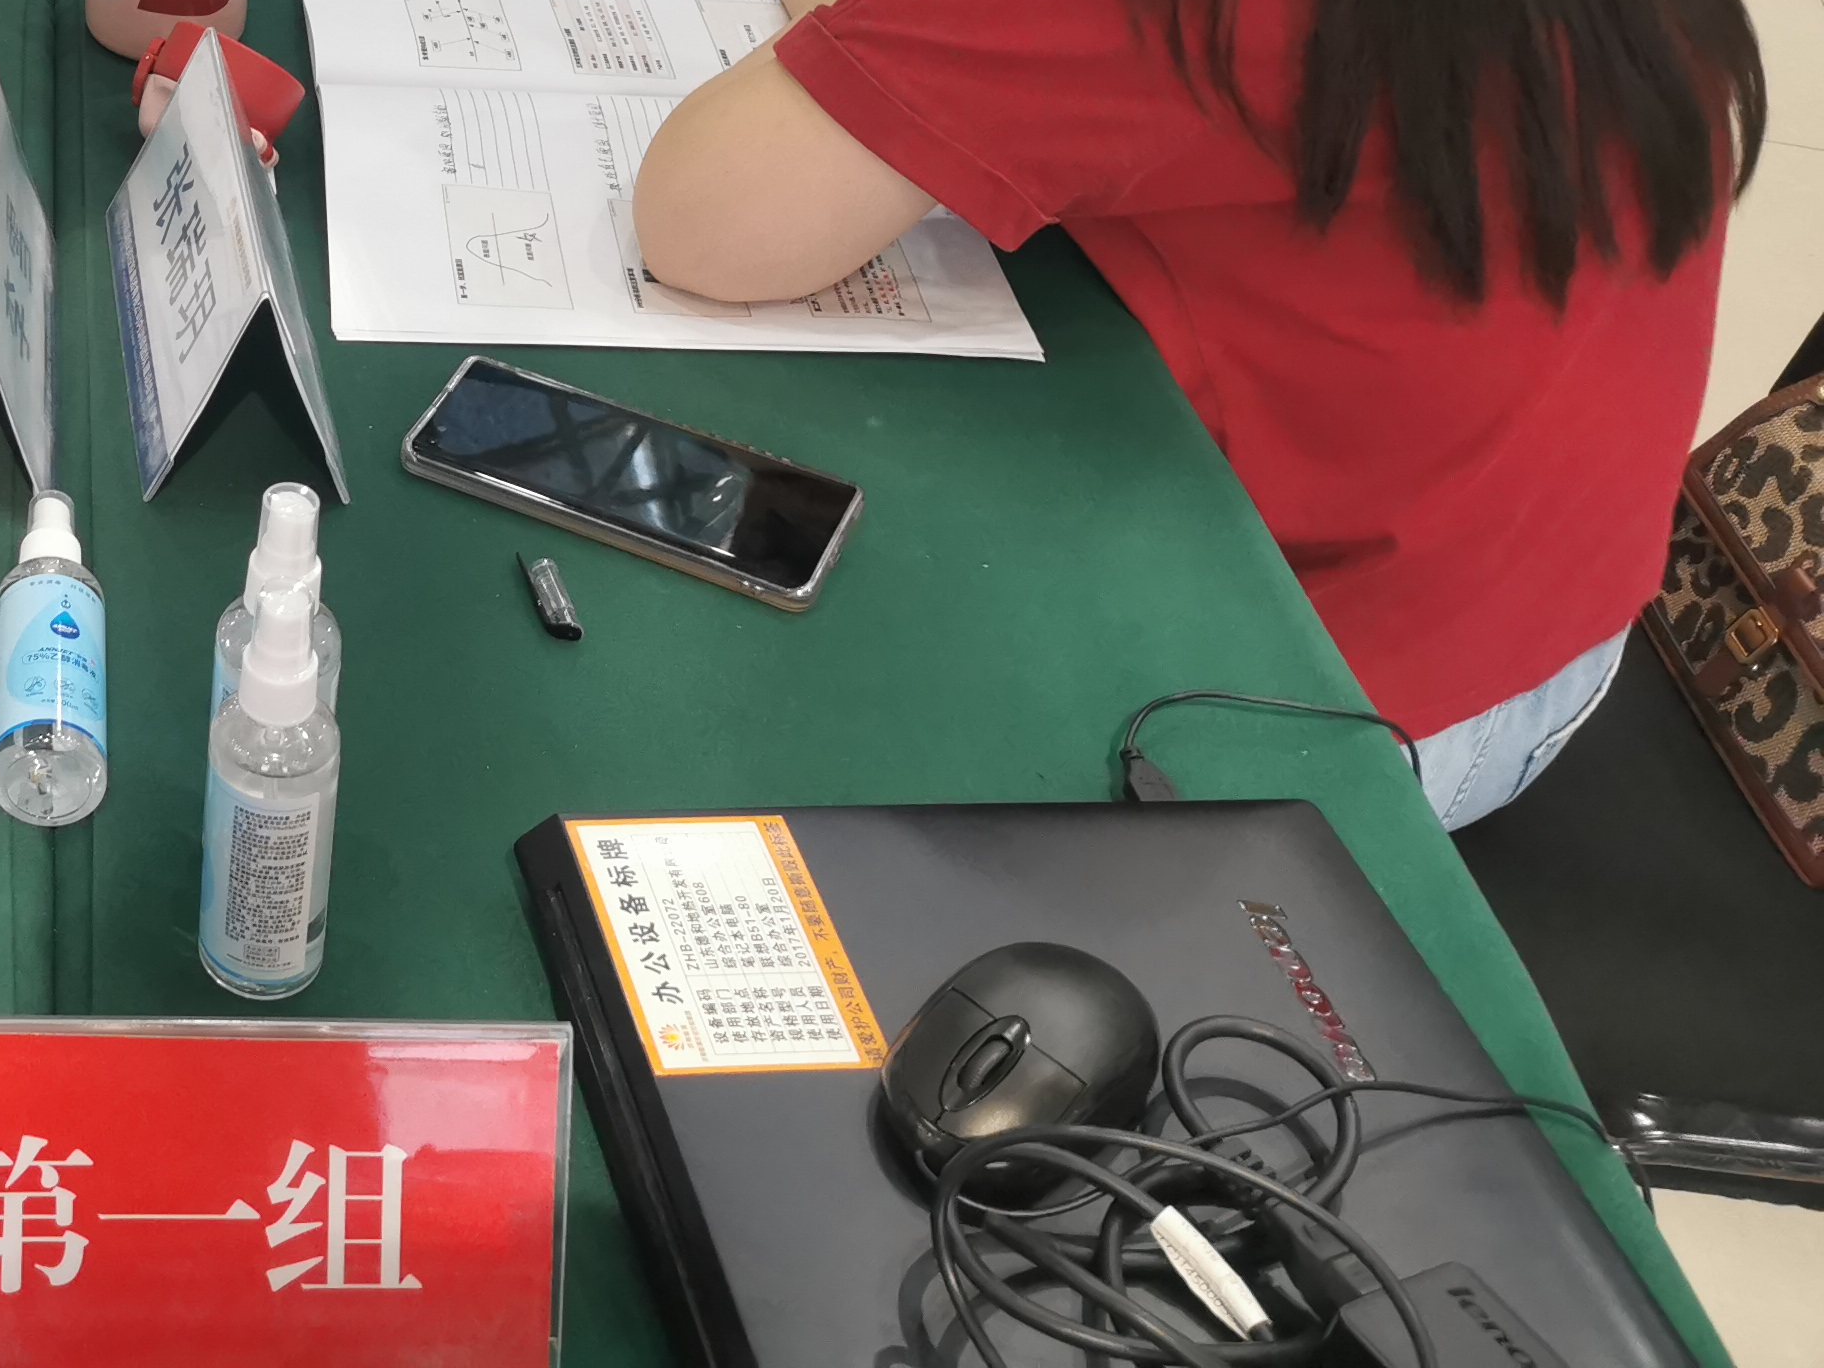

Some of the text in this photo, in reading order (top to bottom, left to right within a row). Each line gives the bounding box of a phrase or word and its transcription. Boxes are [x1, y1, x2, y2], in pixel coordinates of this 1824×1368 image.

[152, 141, 217, 365] 张瑞玥
[594, 837, 685, 1004] 办公设备标牌
[654, 836, 749, 1042] 使用部门 山东德和地热开发有限司
[661, 897, 729, 1043] 设备编码 ZHB-22072
[691, 881, 767, 1042] 存放地点 综合办公室608
[718, 903, 787, 1041] 资产名称 笔记本电脑
[733, 895, 805, 1040] 规格型号 联想B51-80
[754, 902, 824, 1040] 使用人员 综合办公室
[760, 877, 844, 1040] 使用日期 2017年1月20日
